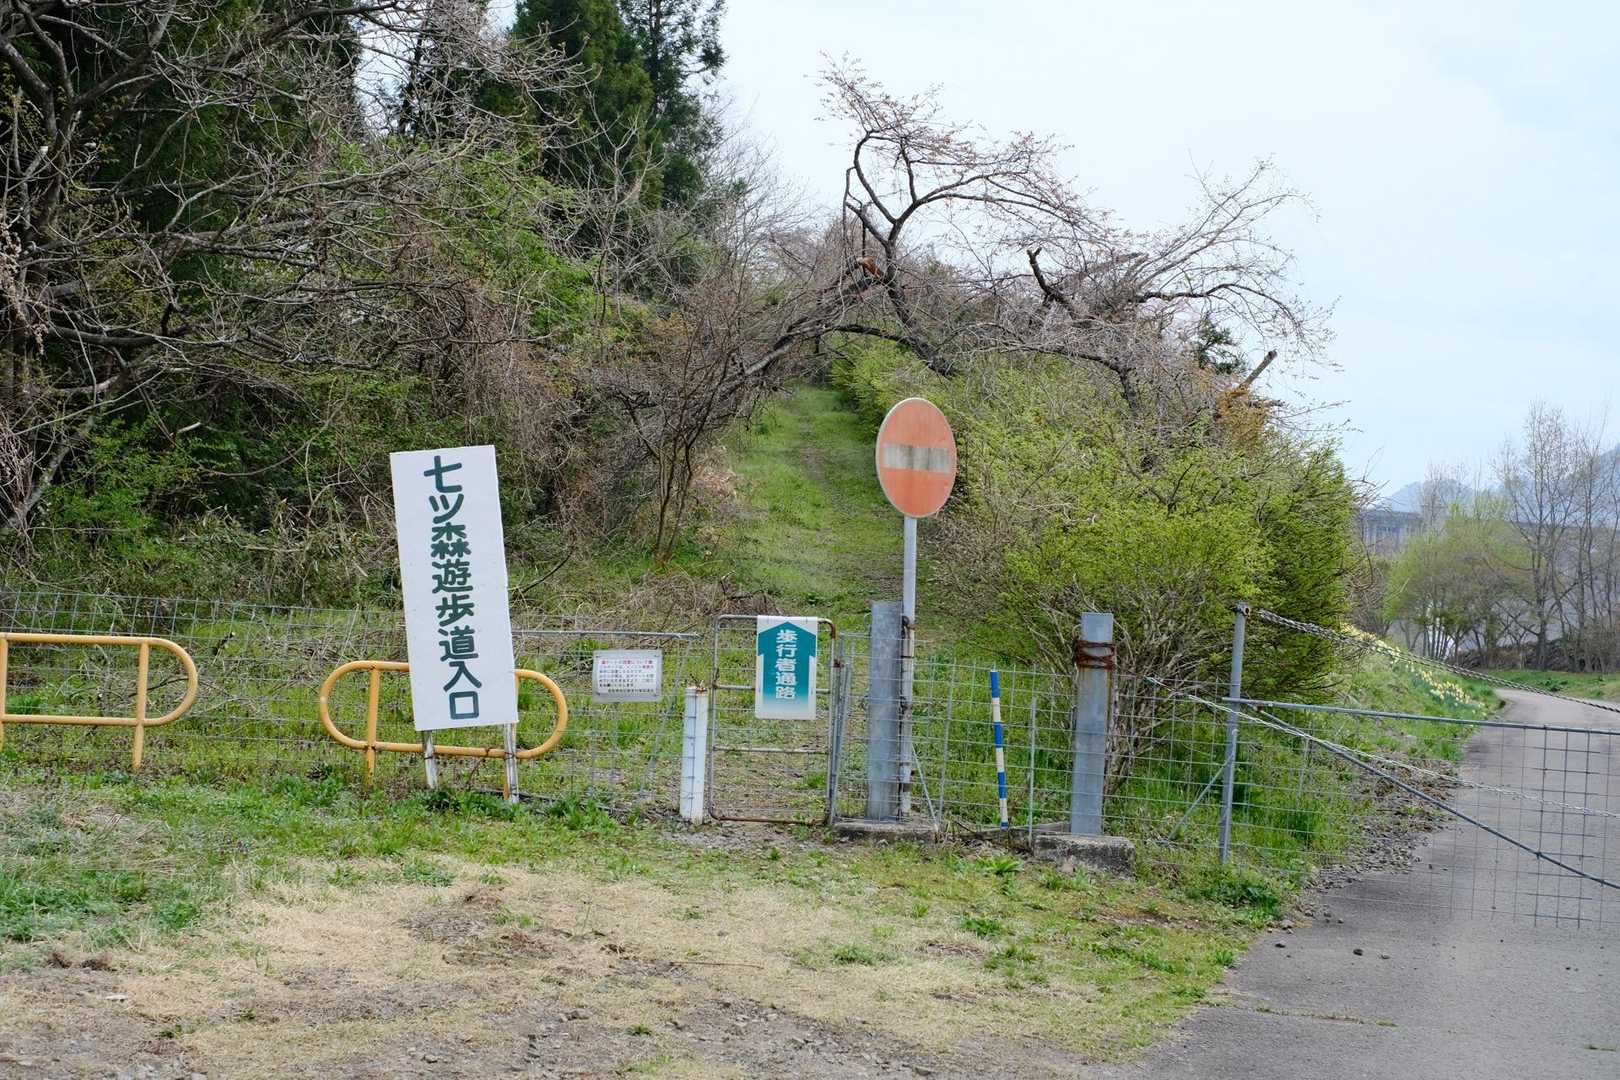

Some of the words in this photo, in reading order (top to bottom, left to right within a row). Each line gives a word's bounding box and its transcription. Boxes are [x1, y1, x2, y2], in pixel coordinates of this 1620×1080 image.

[423, 455, 482, 720] 七ツ森遊歩道入口
[775, 629, 798, 700] 歩行者通路
